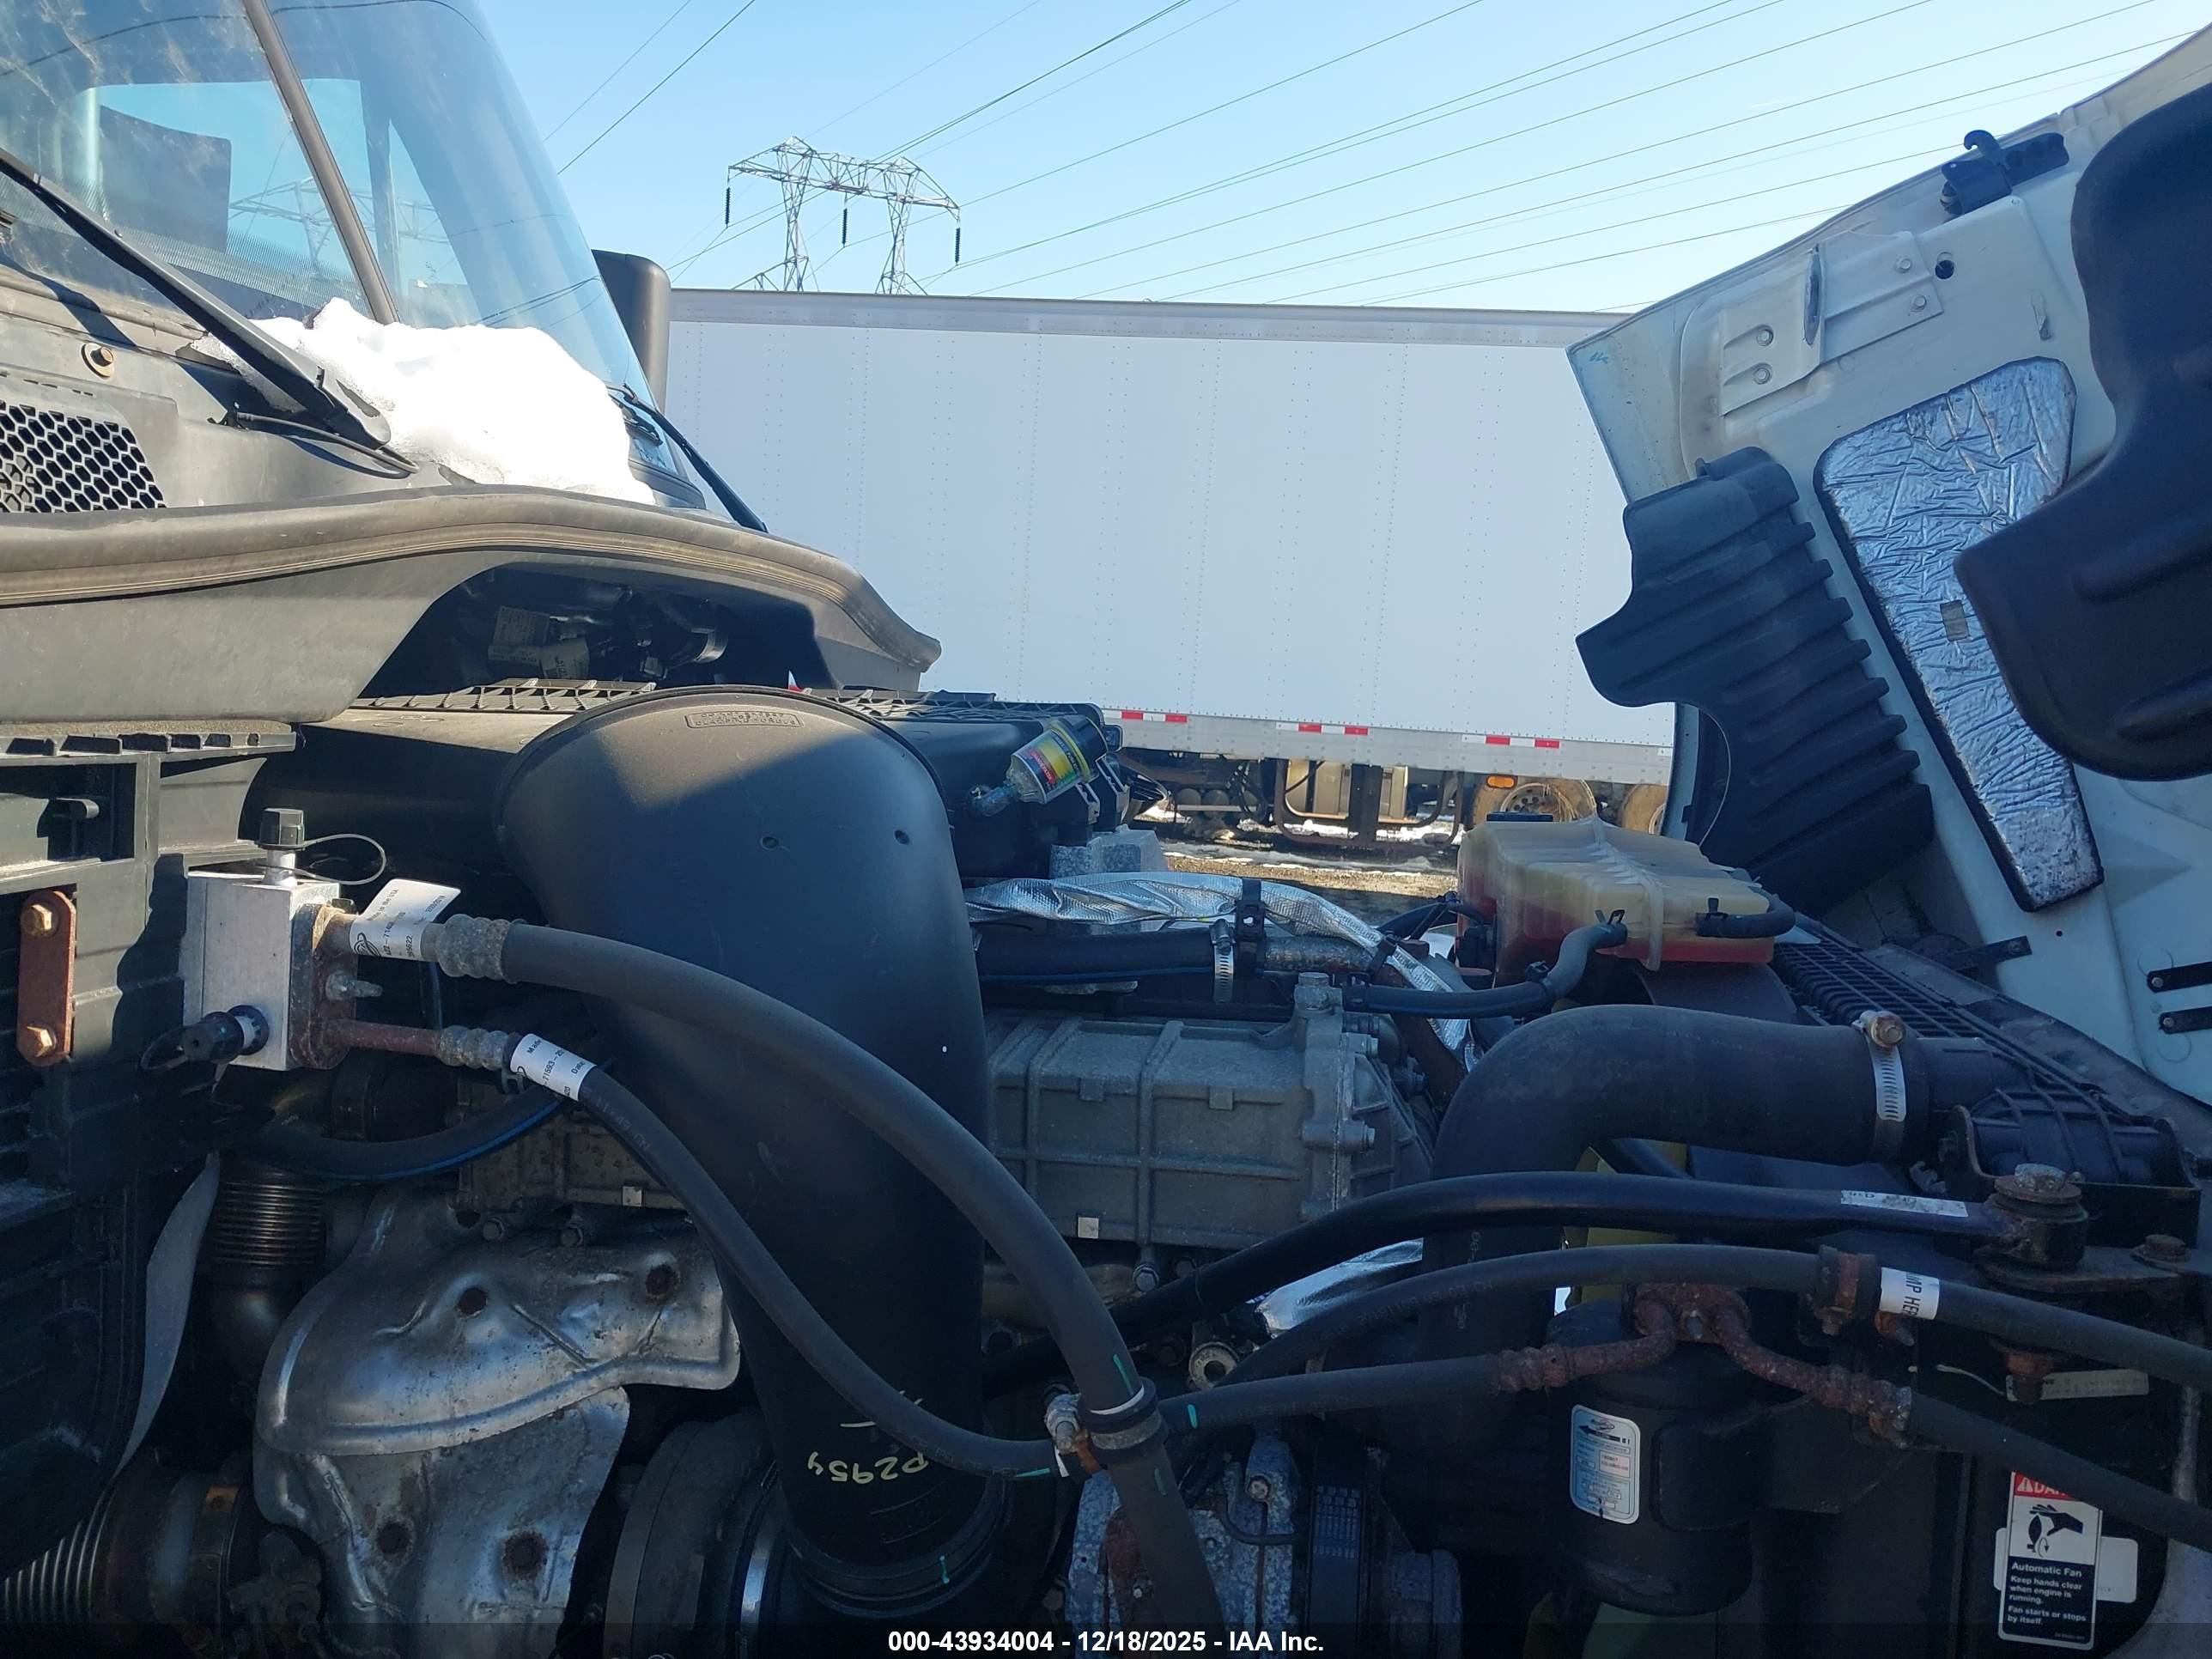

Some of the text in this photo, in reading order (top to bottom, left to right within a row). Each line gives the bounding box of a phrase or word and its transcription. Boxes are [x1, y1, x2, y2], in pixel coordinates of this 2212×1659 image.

[2011, 1562, 2082, 1577] Automatic Fan
[2010, 1576, 2082, 1590] Keep hands clear
[2033, 1587, 2063, 1598] engine
[2008, 1595, 2044, 1605] running.
[2008, 1606, 2023, 1614] Fan
[2025, 1607, 2050, 1617] starts
[2063, 1612, 2087, 1621] stops
[2007, 1615, 2043, 1625] by itself.
